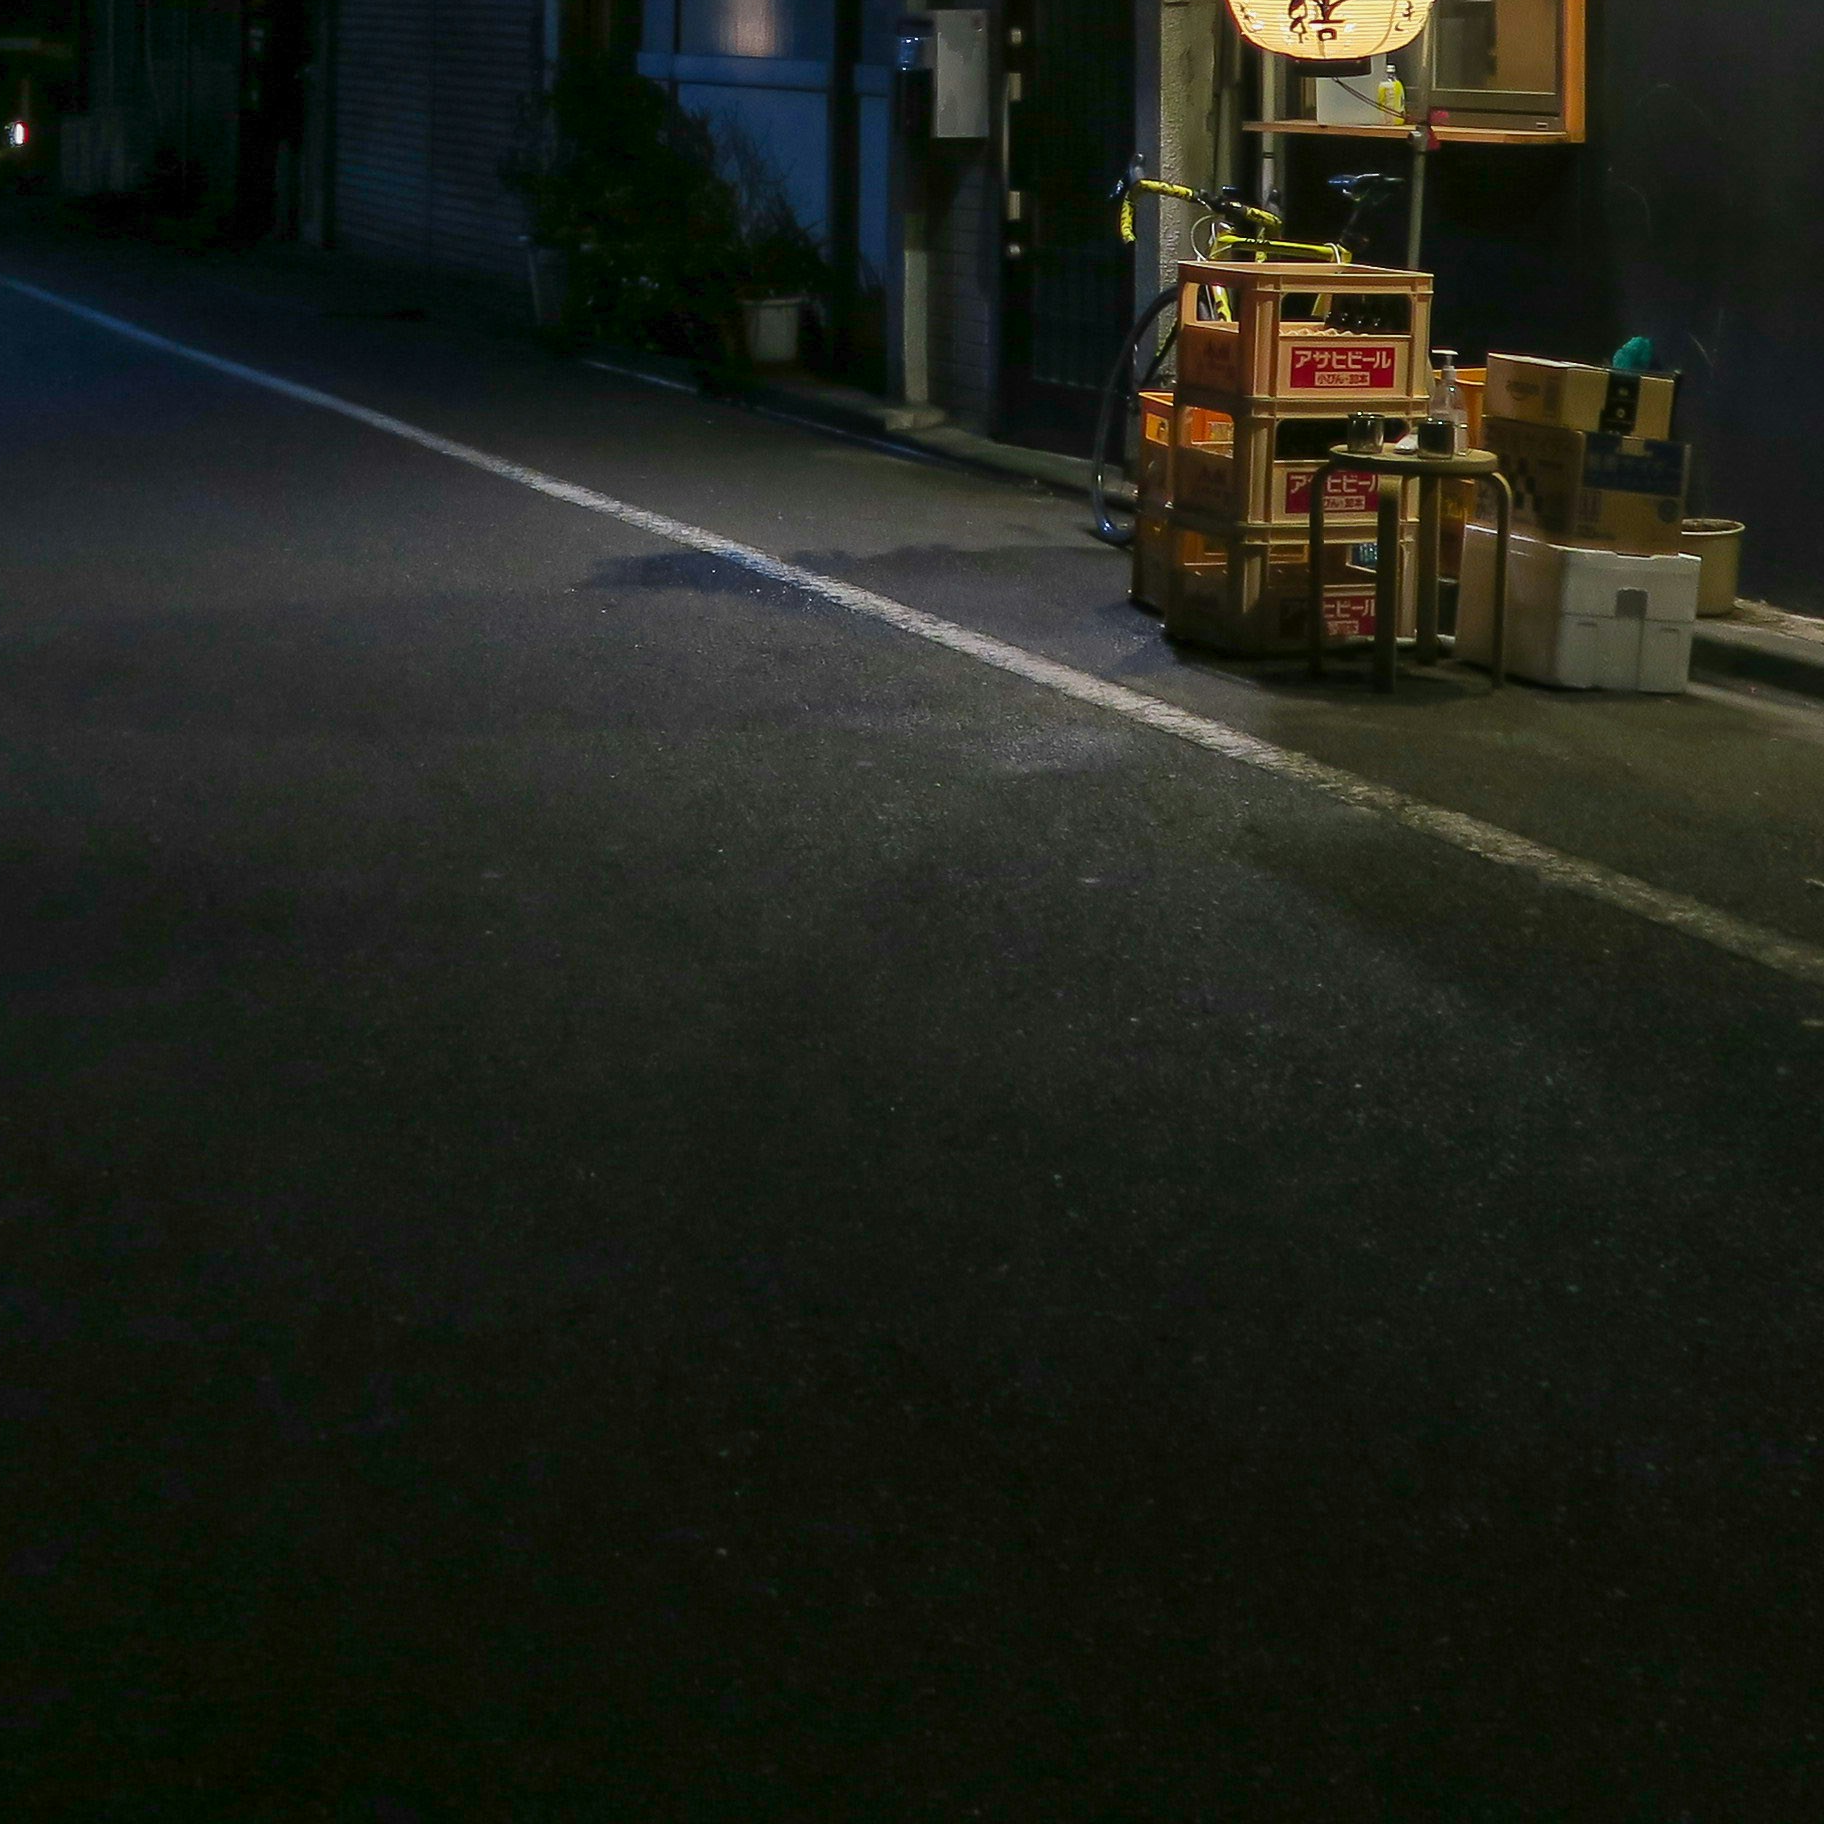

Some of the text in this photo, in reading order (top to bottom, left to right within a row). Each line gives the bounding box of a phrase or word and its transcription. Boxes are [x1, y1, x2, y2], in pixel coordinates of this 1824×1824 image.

[1294, 350, 1392, 369] アサヒビール
